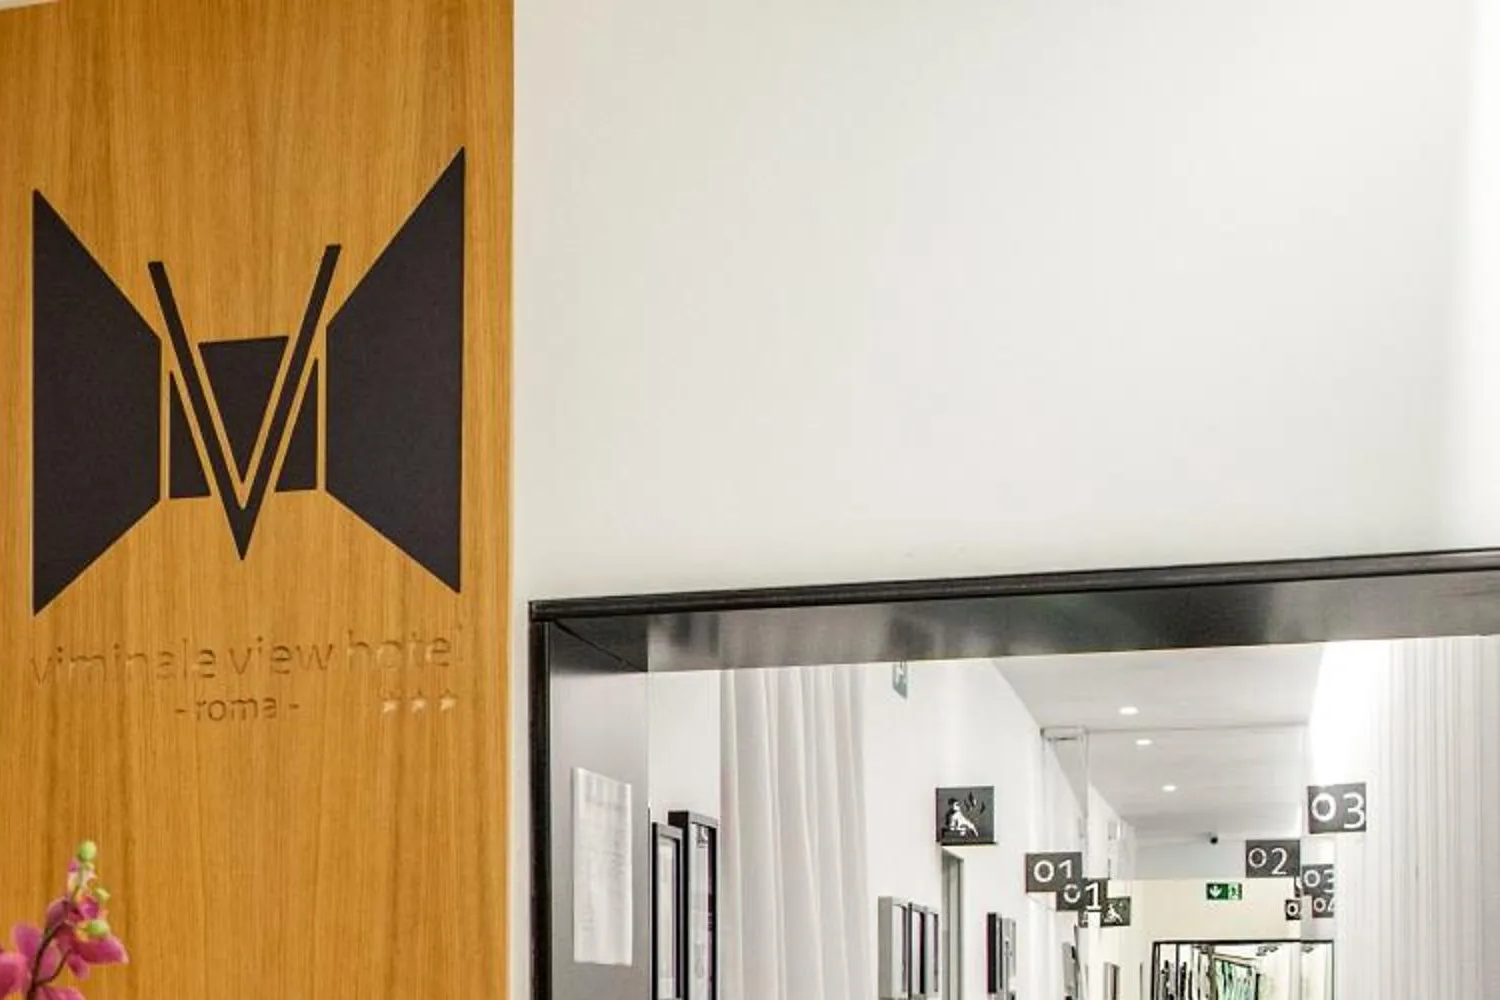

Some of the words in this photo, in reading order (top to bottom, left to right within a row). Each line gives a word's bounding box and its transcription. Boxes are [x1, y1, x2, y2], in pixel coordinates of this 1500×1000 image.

[30, 637, 217, 685] viminale
[228, 636, 334, 676] view
[195, 696, 278, 722] roma
[1311, 792, 1365, 829] 03
[1034, 859, 1072, 882] 01
[1248, 847, 1288, 875] 02
[1063, 882, 1102, 910] 01
